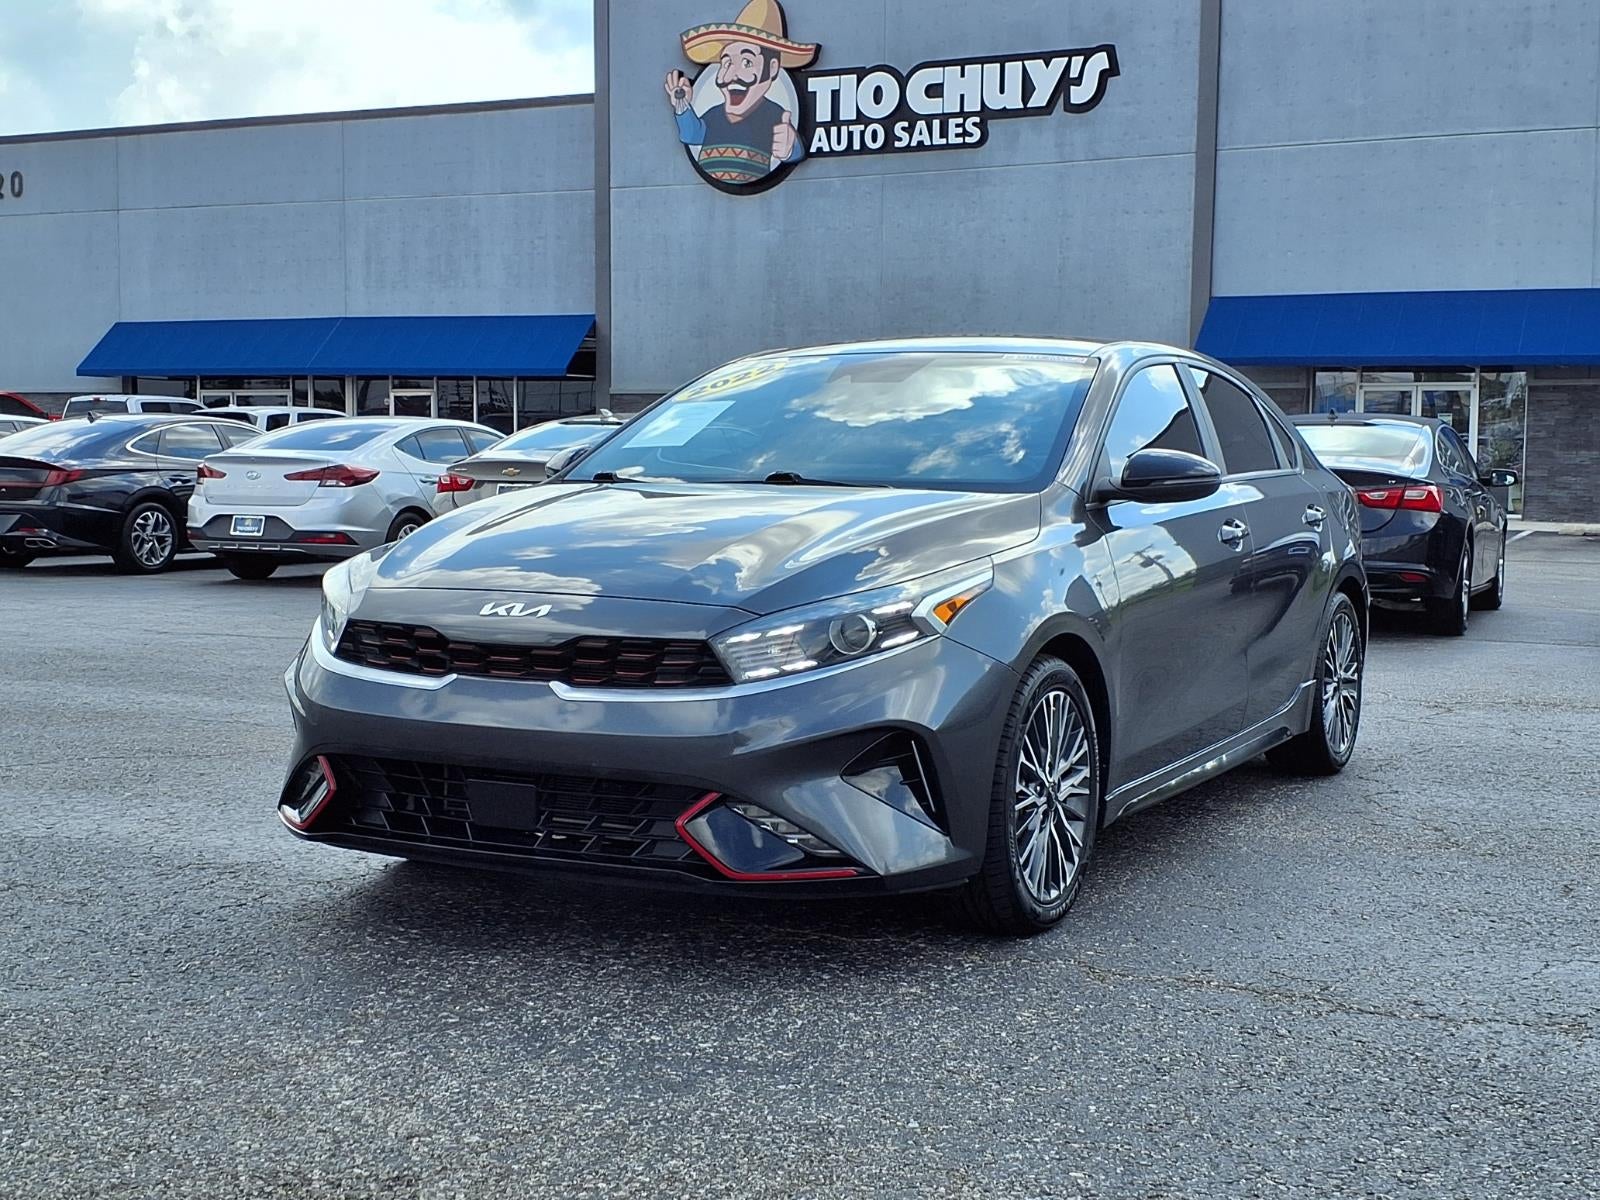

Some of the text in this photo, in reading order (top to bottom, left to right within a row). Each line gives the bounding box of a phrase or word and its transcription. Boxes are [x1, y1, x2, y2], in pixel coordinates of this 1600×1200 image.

[807, 51, 1110, 122] TIO CHUY'S
[809, 116, 982, 152] AUTO SALES
[479, 602, 553, 618] KIA
